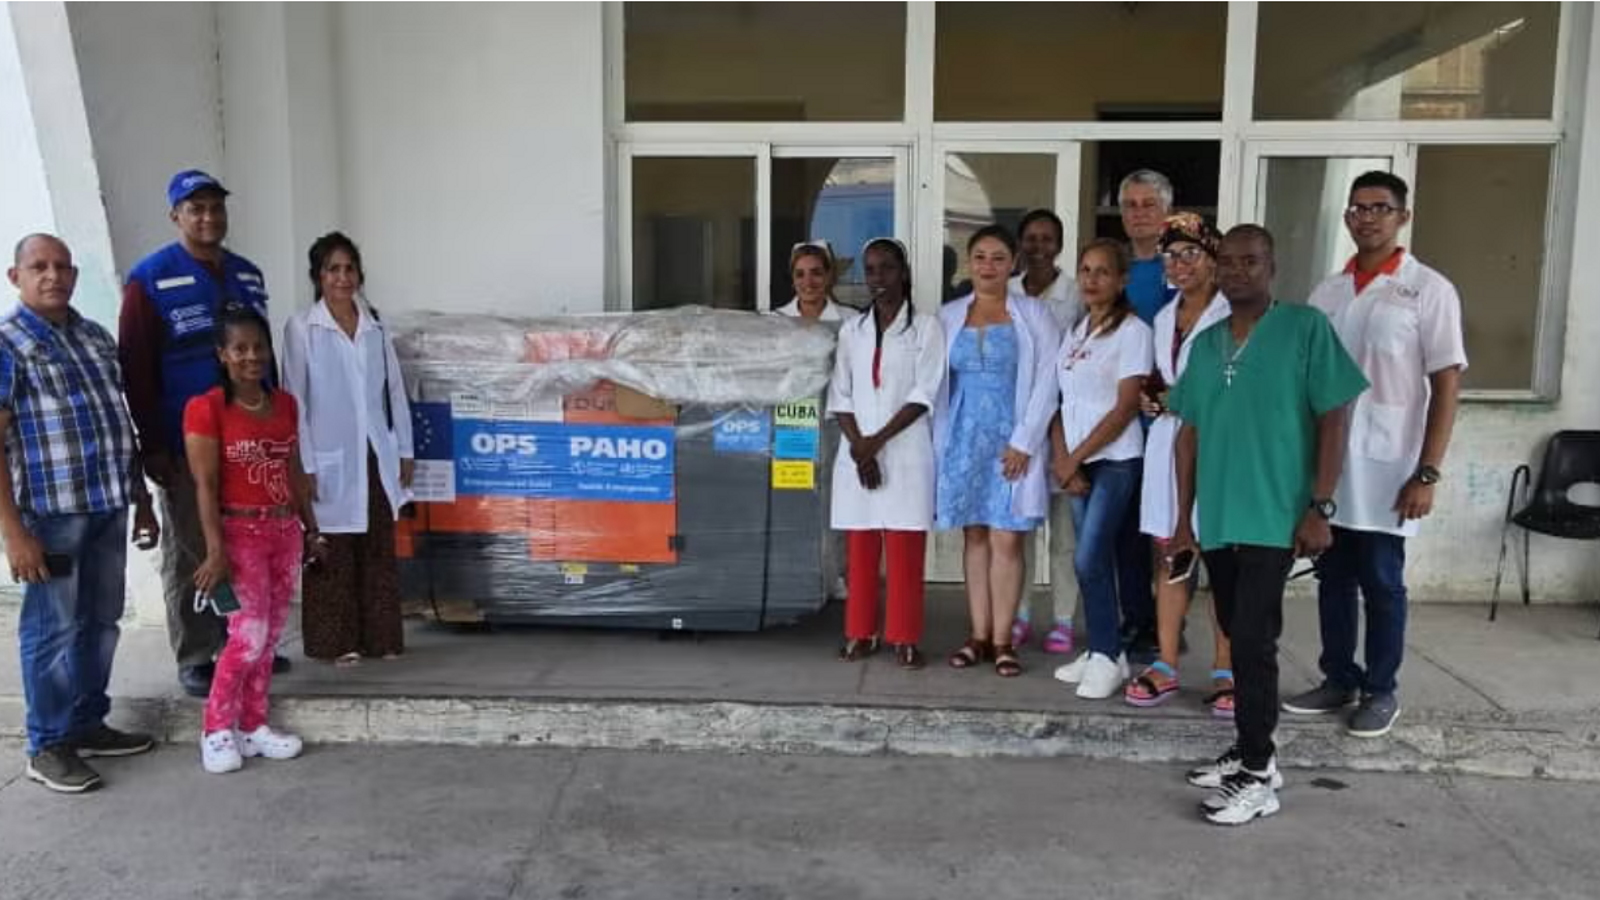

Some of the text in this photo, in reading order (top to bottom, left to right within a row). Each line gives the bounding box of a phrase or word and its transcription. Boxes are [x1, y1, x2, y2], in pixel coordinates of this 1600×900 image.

[777, 405, 817, 420] CUBA
[722, 420, 761, 434] OPS
[470, 433, 538, 455] OPS
[569, 436, 668, 460] PAHO
